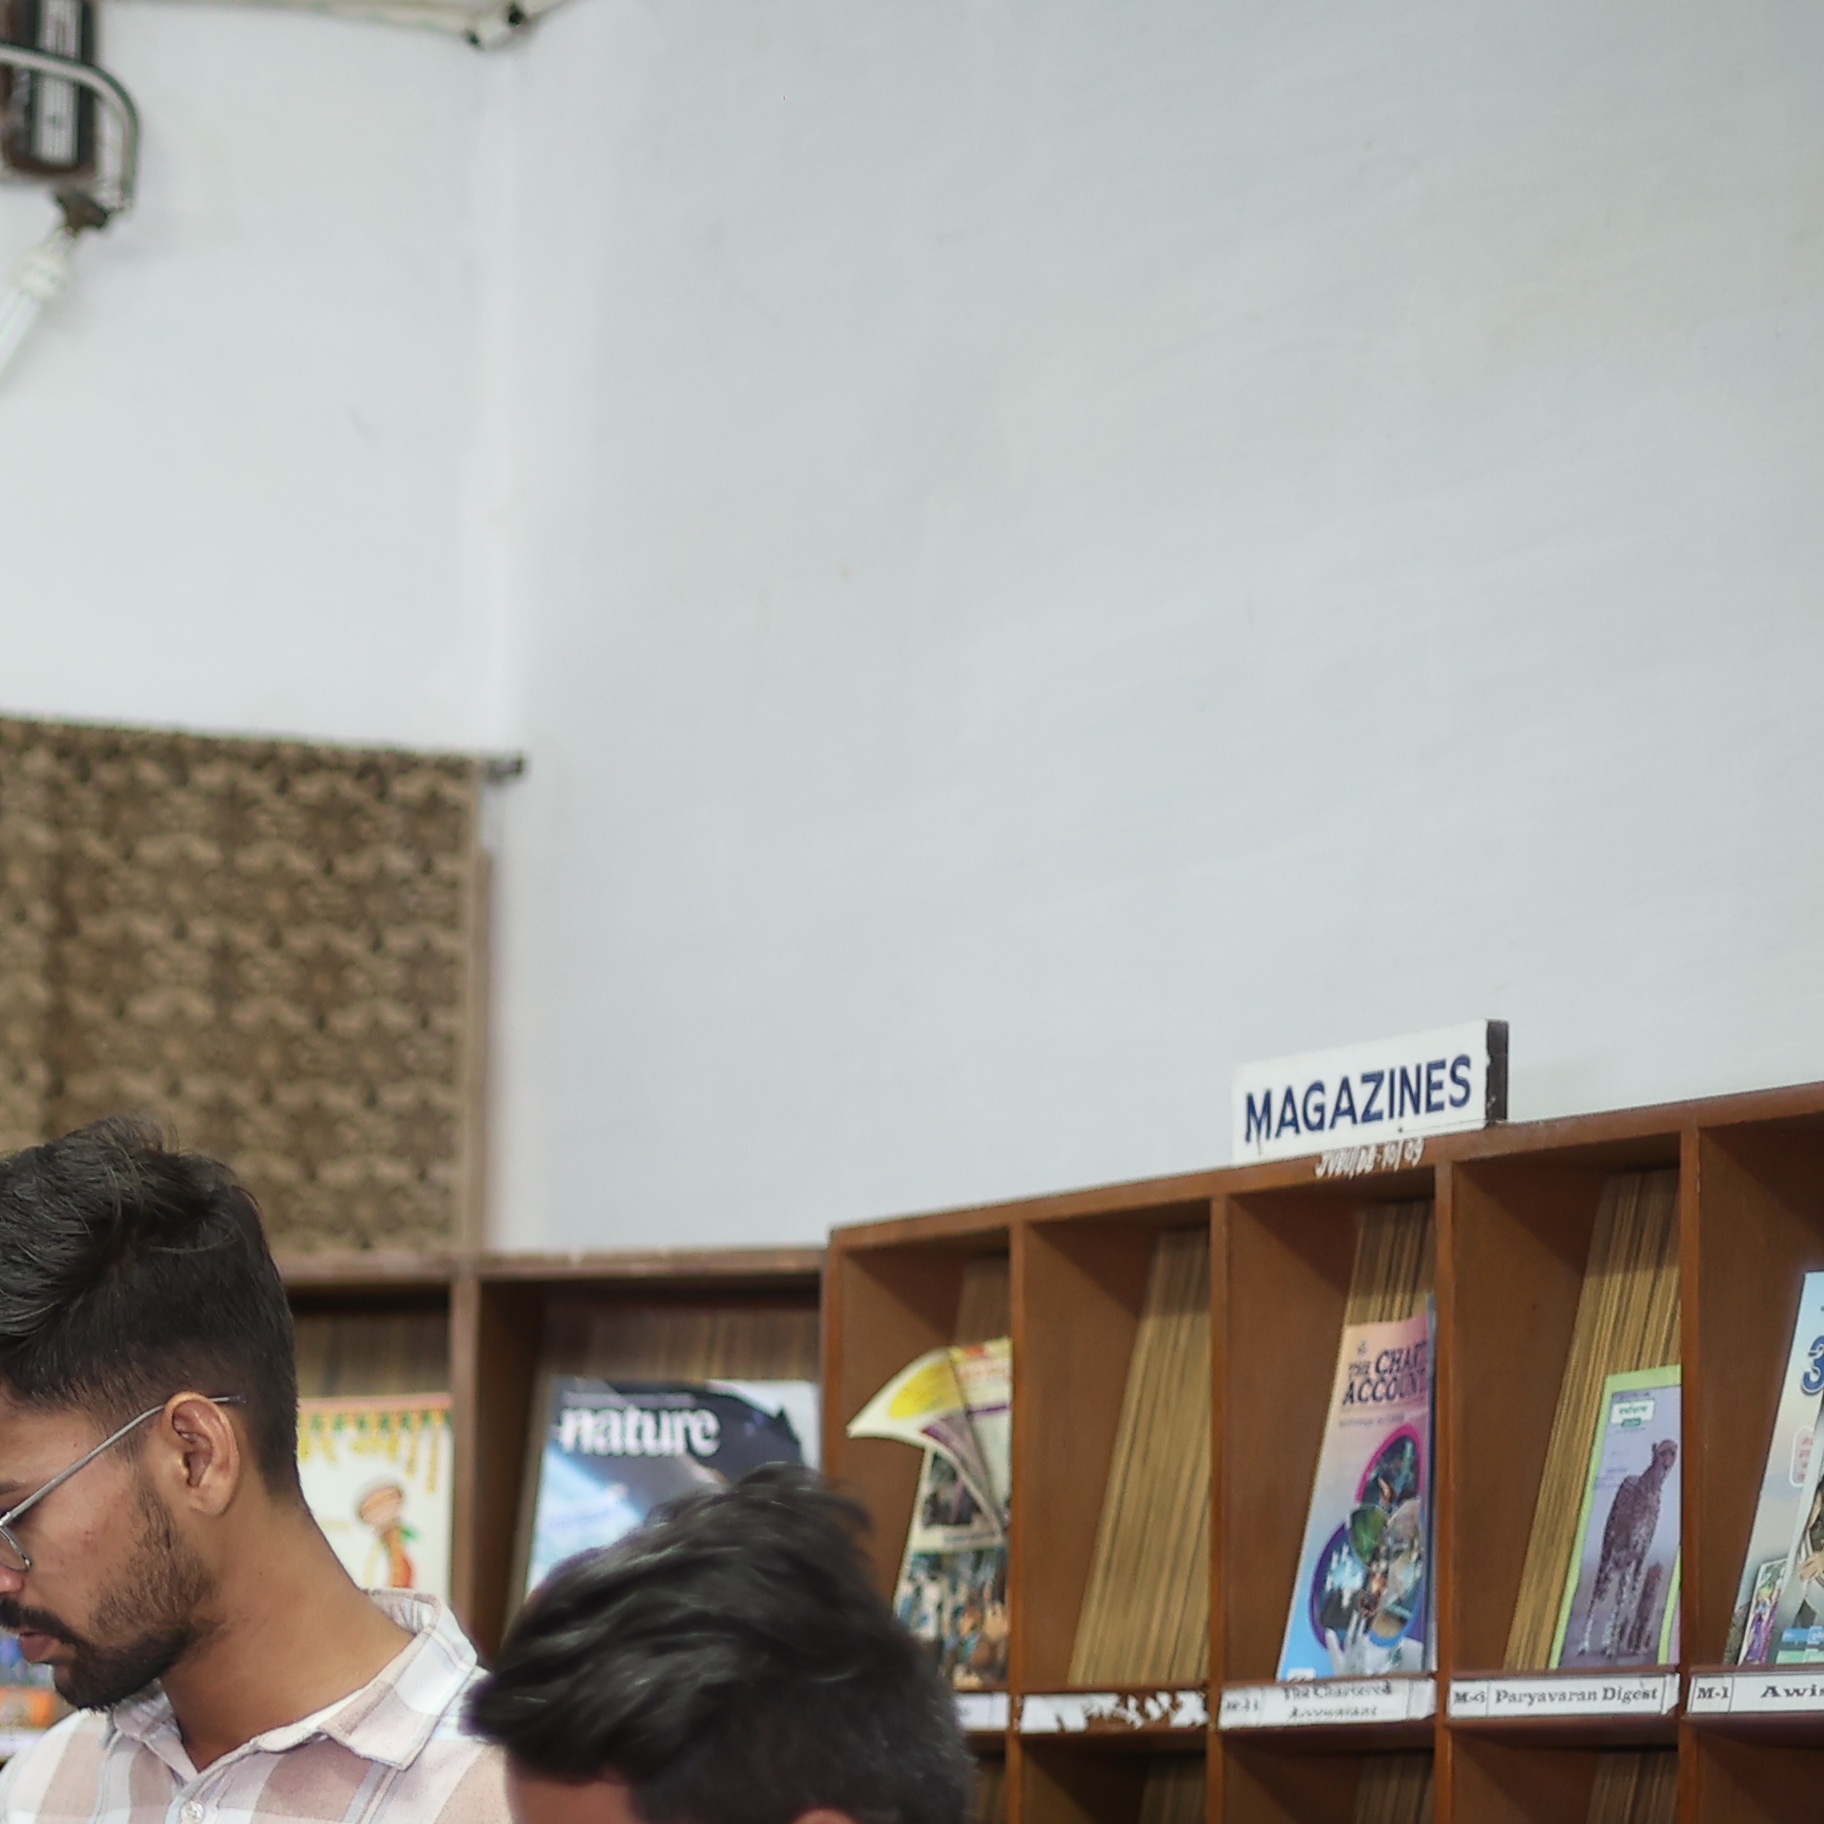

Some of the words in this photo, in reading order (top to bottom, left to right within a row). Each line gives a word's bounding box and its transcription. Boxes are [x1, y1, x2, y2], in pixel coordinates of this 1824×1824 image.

[1244, 1053, 1472, 1144] MAGAZINES
[559, 1403, 722, 1458] nature
[1494, 1688, 1598, 1707] Paryavaran
[1601, 1685, 1659, 1705] Digest
